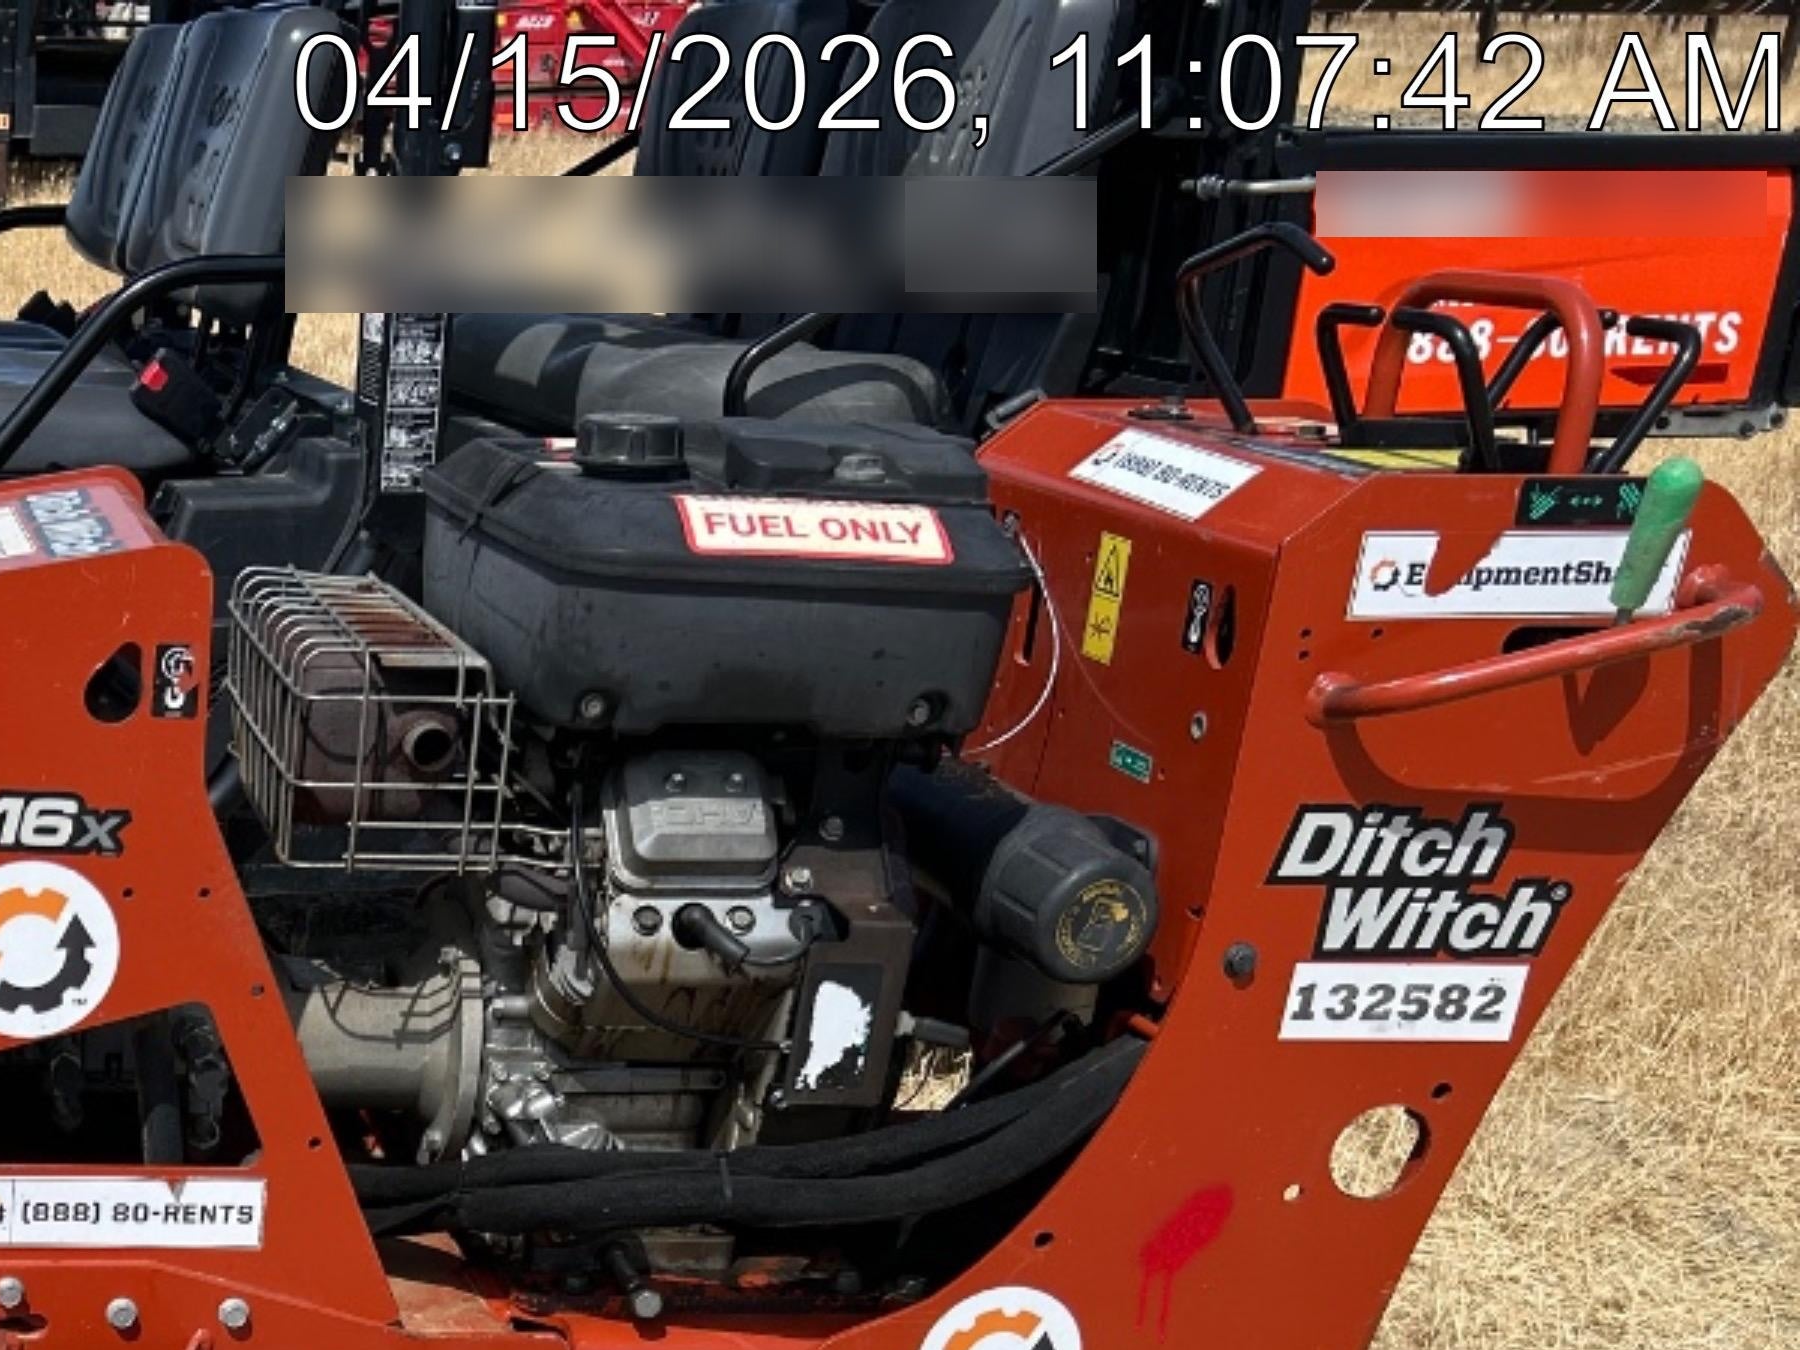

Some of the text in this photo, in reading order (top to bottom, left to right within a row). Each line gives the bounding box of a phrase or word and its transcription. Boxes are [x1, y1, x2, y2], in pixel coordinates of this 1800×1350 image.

[704, 512, 922, 544] FUEL ONLY
[1277, 812, 1507, 877] Ditch
[1322, 887, 1552, 951] Witch
[1290, 983, 1507, 1022] 132582
[21, 1202, 254, 1226] (888) 80-RENTS
